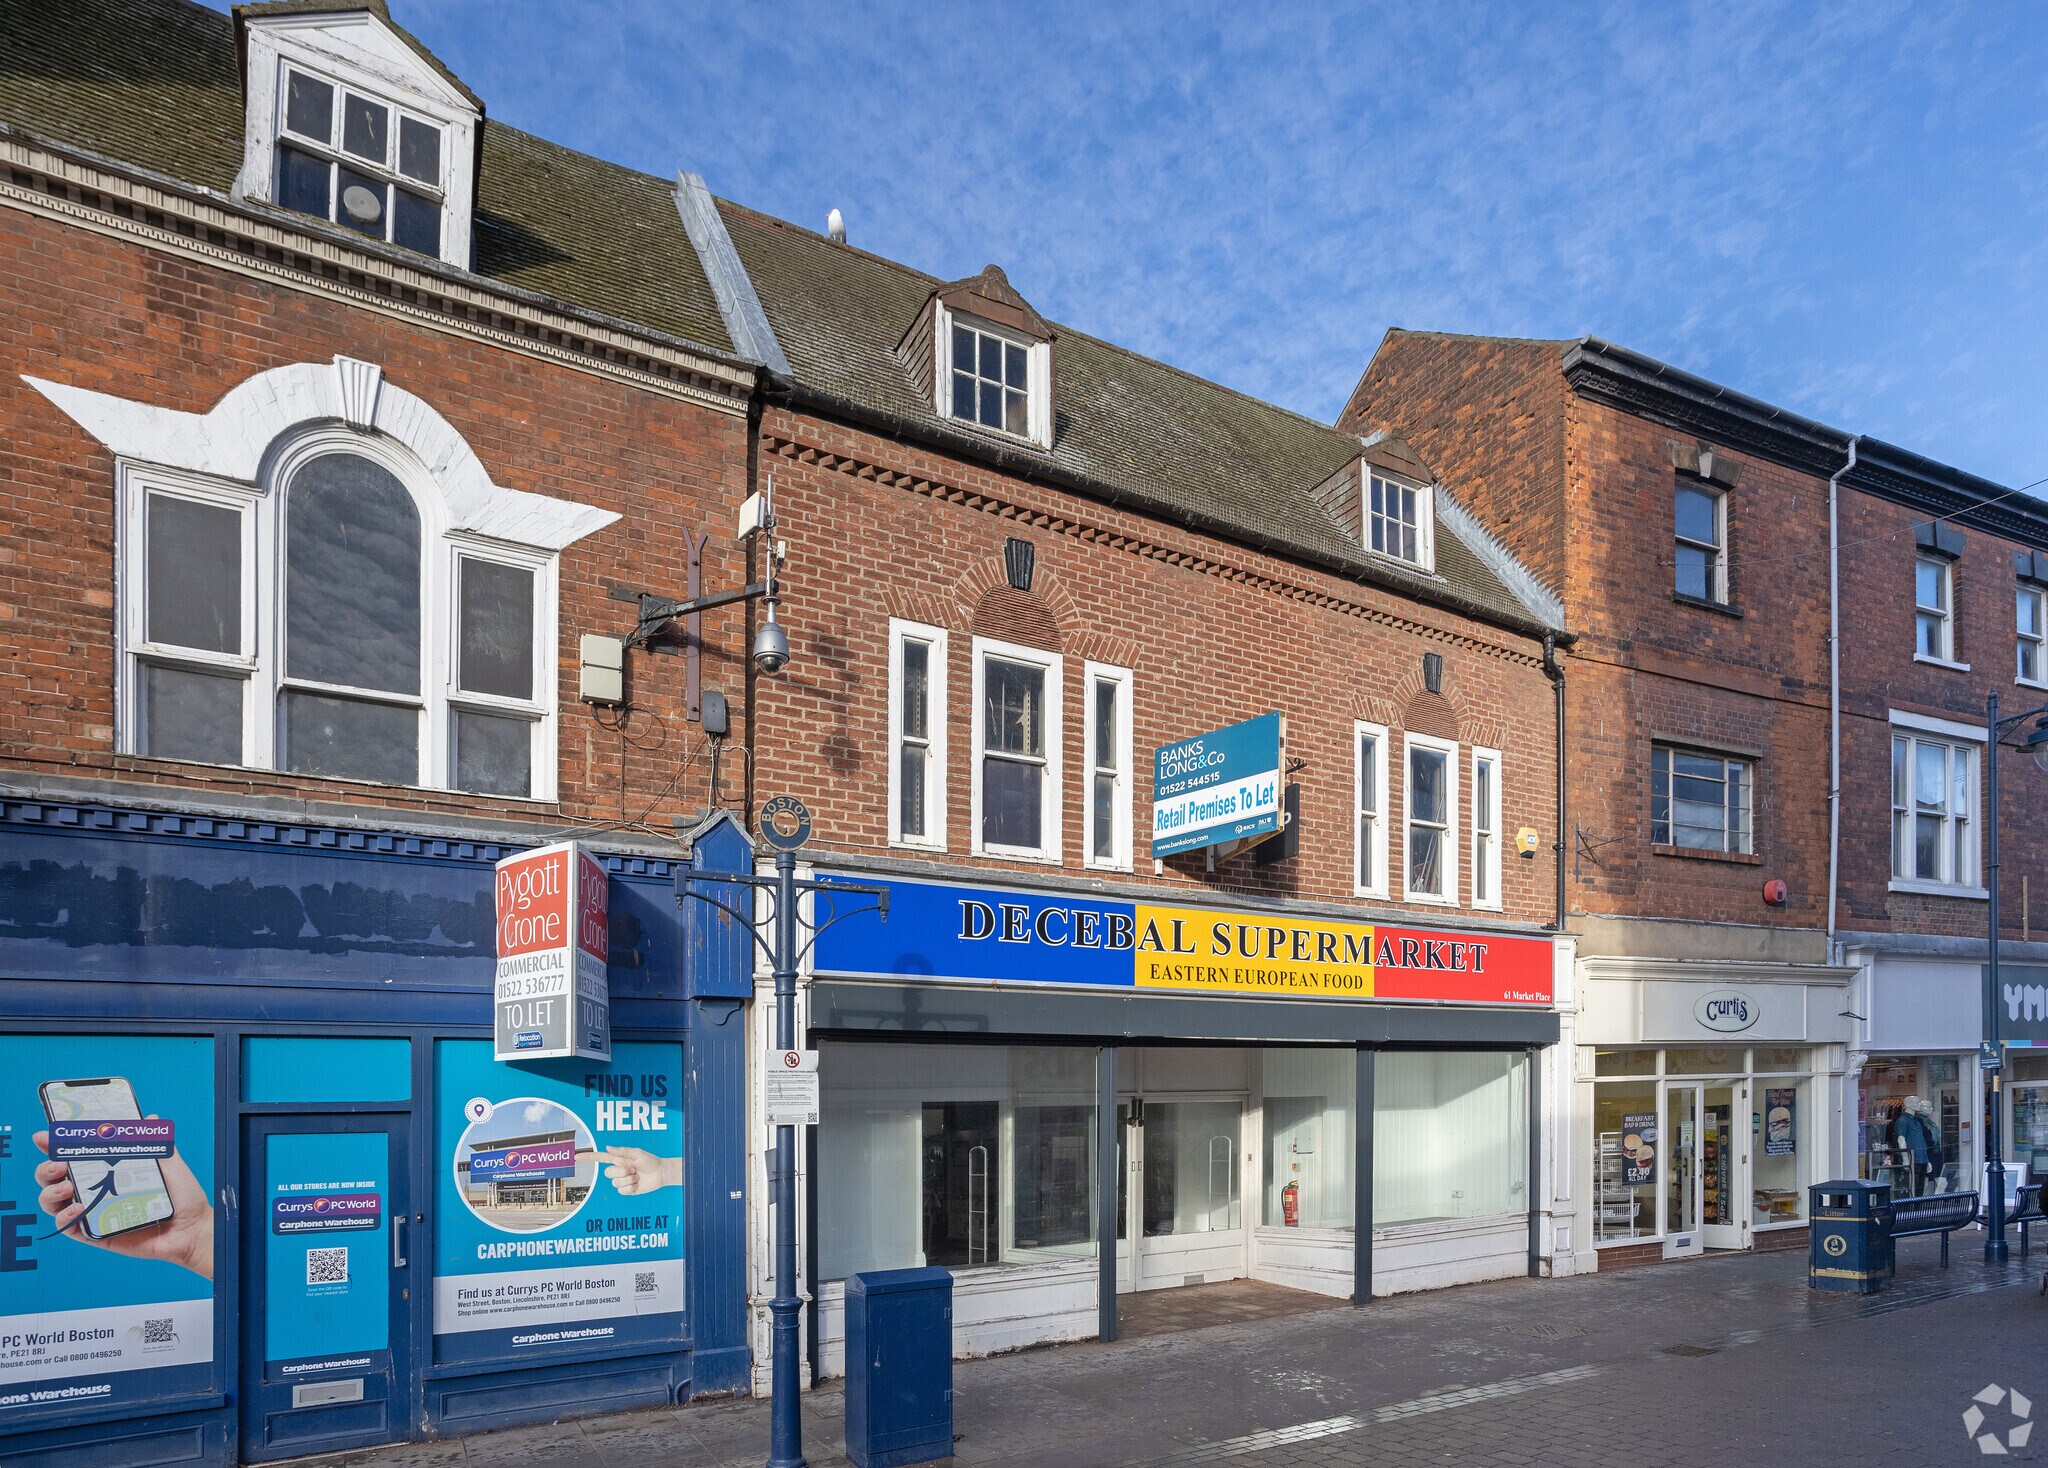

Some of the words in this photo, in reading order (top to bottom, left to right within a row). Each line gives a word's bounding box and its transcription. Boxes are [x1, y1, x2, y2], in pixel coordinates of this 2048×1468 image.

[1161, 741, 1204, 766] BANKS
[1160, 751, 1225, 780] LONG&Co
[1160, 780, 1185, 795] 01522
[1188, 772, 1220, 788] 544515
[762, 798, 810, 826] BOSTON
[1156, 804, 1186, 831] Retail
[1190, 794, 1236, 823] Premises
[1240, 787, 1252, 810] To
[1256, 780, 1274, 807] Let
[1156, 834, 1208, 850] www.bankslong.com
[500, 858, 560, 911] Pygott
[580, 857, 606, 914] Pygott
[504, 912, 560, 948] Crone
[584, 909, 606, 955] Crone
[958, 900, 1196, 954] DECEBAL
[1211, 922, 1488, 974] SUPERMARKET
[499, 953, 564, 978] COMMERCIAL
[1150, 963, 1229, 985] EASTERN
[1234, 968, 1319, 988] EUROPEAN
[1324, 973, 1364, 990] FOOD
[498, 980, 522, 999] 01522
[526, 974, 564, 994] 536777
[1504, 990, 1510, 1000] 61
[1512, 991, 1534, 1000] Market
[1536, 992, 1551, 1002] Place
[1706, 998, 1748, 1021] Curtis
[2004, 983, 2048, 1022] YM
[504, 1004, 523, 1030] TO
[528, 1000, 554, 1027] LET
[582, 1000, 594, 1028] TO
[594, 1006, 605, 1031] LET
[584, 1074, 633, 1098] FIND
[641, 1074, 668, 1097] US
[596, 1100, 668, 1131] HERE
[55, 1127, 96, 1138] Currys
[118, 1126, 134, 1136] PC
[134, 1126, 169, 1135] World
[56, 1146, 108, 1156] Carphone
[109, 1145, 166, 1154] Warehouse
[474, 1158, 504, 1168] Currys
[522, 1153, 536, 1164] PC
[538, 1150, 570, 1162] World
[1628, 1167, 1650, 1176] £2.40
[278, 1203, 314, 1212] Currys
[331, 1200, 346, 1209] PC
[346, 1200, 376, 1209] World
[280, 1220, 324, 1229] Carphone
[324, 1218, 374, 1226] Warehouse
[586, 1218, 602, 1233] OR
[607, 1216, 651, 1232] ONLINE
[654, 1215, 668, 1230] AT
[478, 1232, 668, 1260] CARPHONEWAREHOUSE.COM
[458, 1288, 478, 1299] Find
[482, 1290, 492, 1298] us
[495, 1286, 504, 1296] at
[508, 1285, 538, 1296] Currys
[541, 1282, 554, 1292] PC
[556, 1280, 582, 1291] World
[584, 1278, 616, 1289] Boston
[513, 1296, 546, 1304] Lincolnshire,
[490, 1301, 568, 1313] www.carphonewarehouse.com
[2, 1335, 20, 1348] PC
[25, 1331, 64, 1346] World
[69, 1328, 114, 1342] Boston
[512, 1331, 560, 1344] Carphone
[560, 1326, 614, 1339] Warehouse
[10, 1349, 29, 1358] PE21
[54, 1355, 68, 1363] Call
[70, 1352, 88, 1361] 0800
[90, 1349, 122, 1359] 0496250
[282, 1363, 324, 1372] Carphone
[324, 1358, 371, 1368] Warehouse
[30, 1384, 111, 1401] Warehouse
